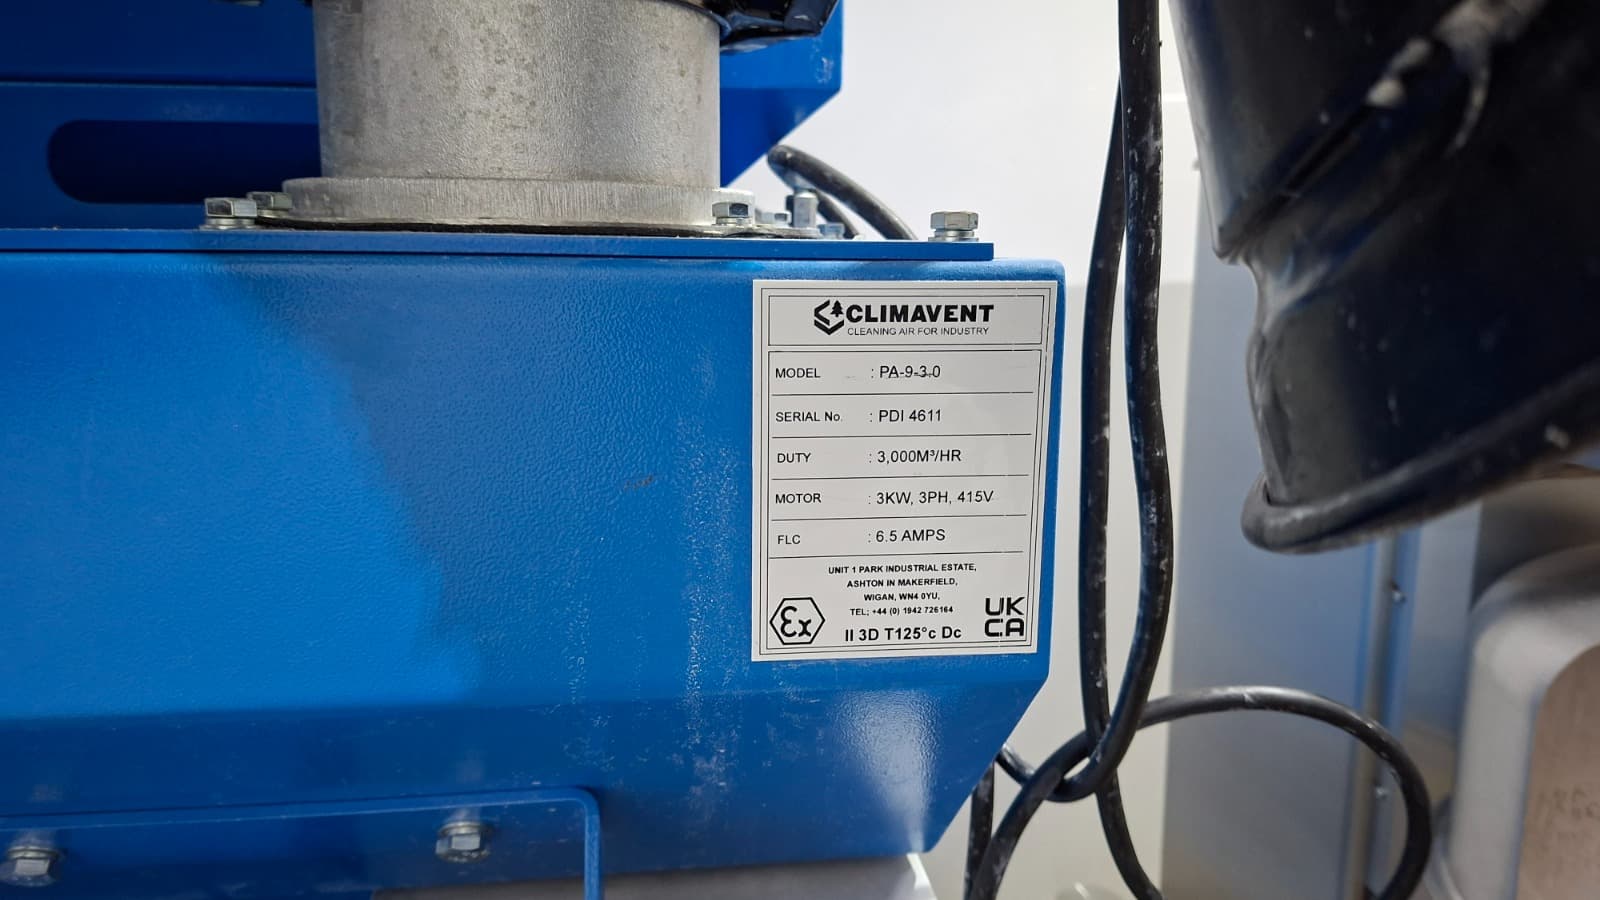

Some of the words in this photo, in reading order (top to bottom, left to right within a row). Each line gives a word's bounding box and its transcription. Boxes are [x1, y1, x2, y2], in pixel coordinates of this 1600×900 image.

[846, 304, 994, 323] CLIMAVENT
[847, 327, 897, 336] CLEANING
[899, 327, 916, 336] AIR
[917, 327, 939, 336] FOR
[940, 326, 990, 336] INDUSTRY
[775, 368, 821, 379] MODEL
[775, 411, 821, 423] SERIAL
[878, 409, 904, 423] PDI
[908, 408, 942, 422] 4611
[776, 452, 812, 464] DUTY
[775, 492, 822, 505] MOTOR
[876, 491, 914, 507] 3KW,
[918, 490, 952, 506] 3PH,
[957, 490, 994, 504] 415V
[777, 534, 801, 545] FLC
[875, 530, 898, 543] 6.5
[901, 528, 946, 542] AMPS
[828, 565, 850, 575] UNIT
[851, 566, 857, 574] 1
[858, 565, 884, 574] PARK
[885, 563, 939, 573] INDUSTRIAL
[941, 562, 977, 572] ESTATE,
[847, 578, 884, 588] ASHTON
[886, 578, 896, 587] IN
[897, 577, 959, 587] MAKERFIELD,
[863, 593, 897, 602] WIGAN,
[899, 592, 919, 601] WN4
[871, 607, 887, 616] +44
[889, 606, 900, 616] (0)
[902, 605, 922, 615] 1942
[924, 605, 954, 614] 726164
[985, 597, 1025, 616] UK
[858, 628, 880, 641] 3D
[941, 625, 962, 639] Dc
[985, 618, 1025, 637] CA
